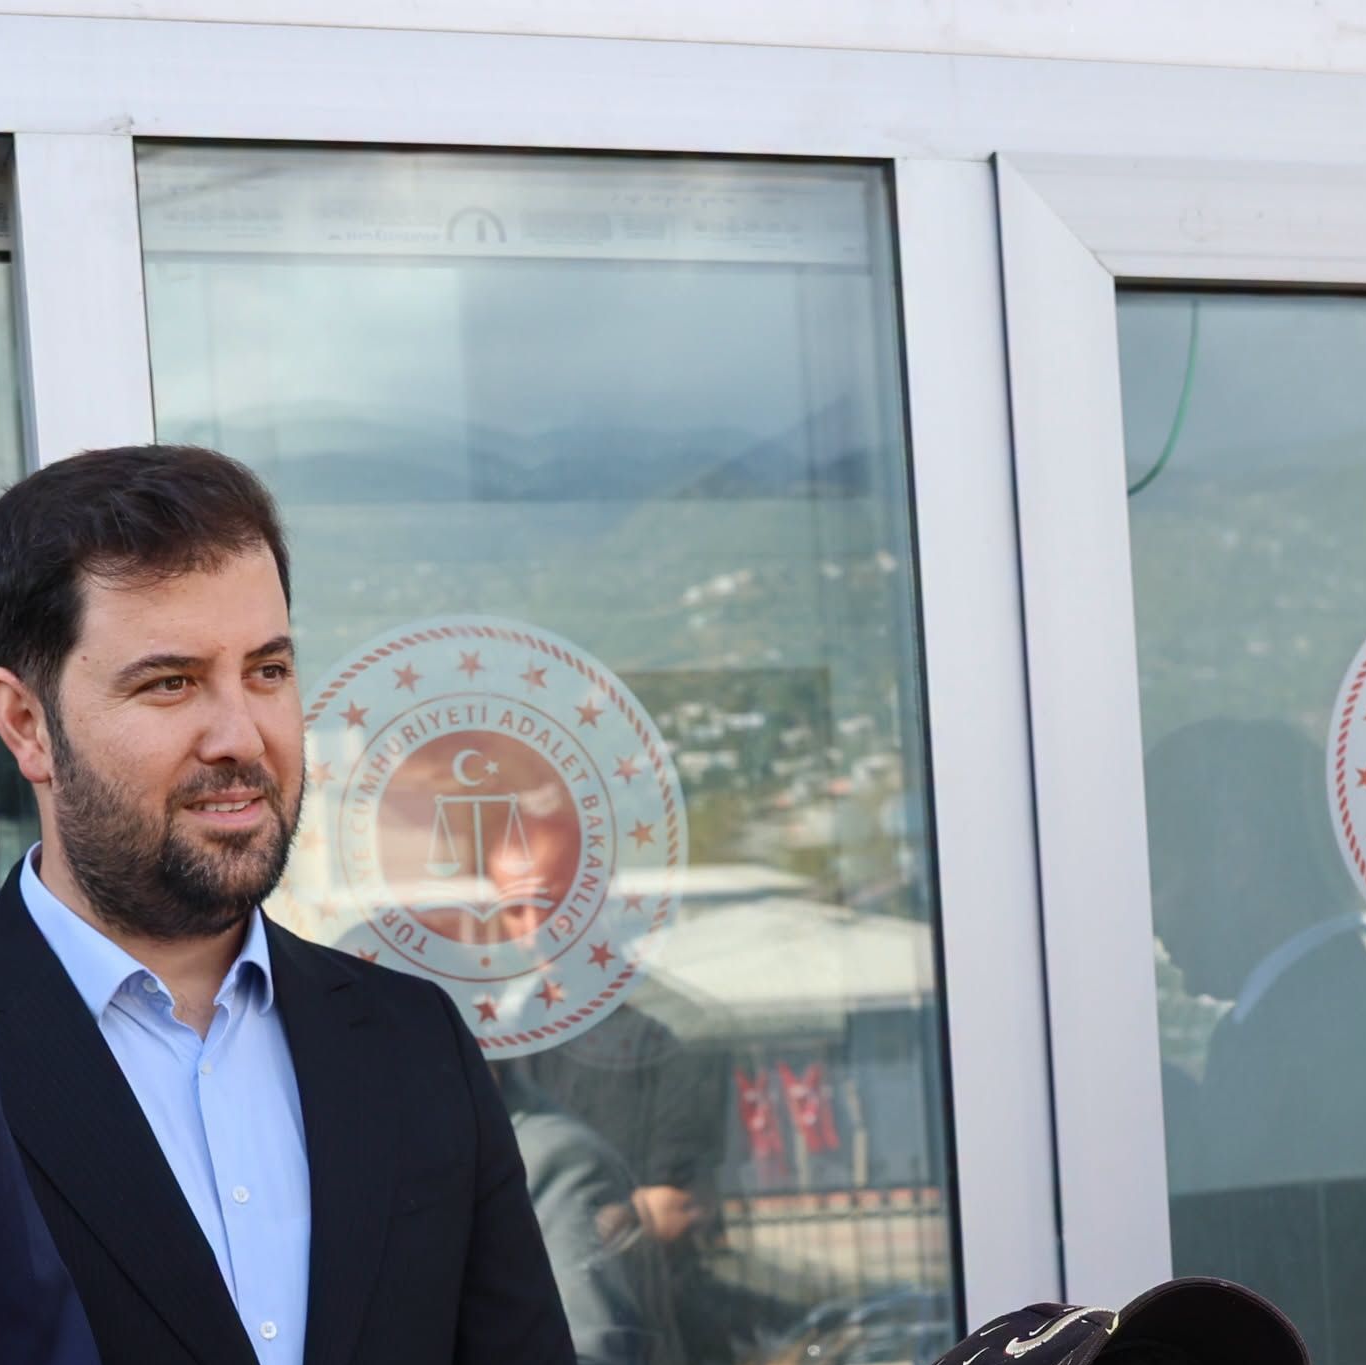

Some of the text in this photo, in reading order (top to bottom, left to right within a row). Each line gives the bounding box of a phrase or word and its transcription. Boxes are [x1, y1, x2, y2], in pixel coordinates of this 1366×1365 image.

[350, 706, 605, 955] TÜRYE CUMHURİYETİ ADALET BAKANLIĞI
